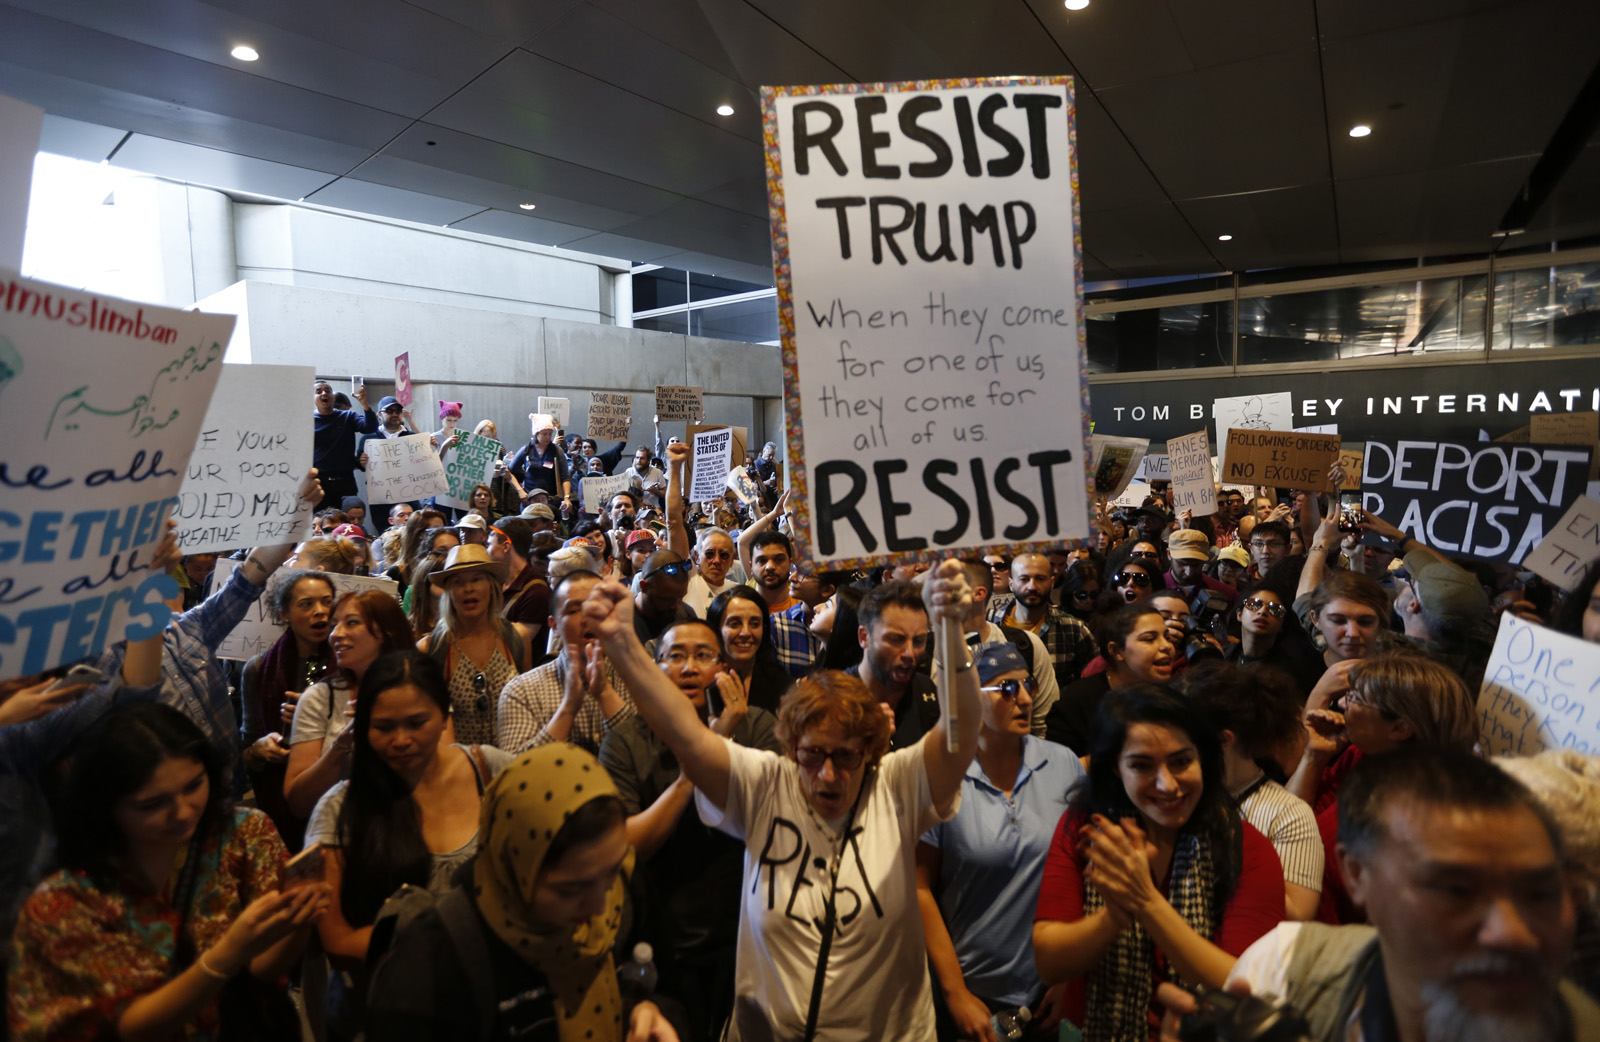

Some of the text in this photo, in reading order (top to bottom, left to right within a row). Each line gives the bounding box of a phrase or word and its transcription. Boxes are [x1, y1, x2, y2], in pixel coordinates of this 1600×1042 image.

[793, 93, 1062, 179] RESIST
[816, 196, 1037, 270] TRUMP
[807, 291, 1069, 345] When they come
[837, 334, 1045, 380] for one of us,
[591, 392, 609, 404] YOUR
[818, 381, 1036, 428] they come for
[1113, 405, 1169, 422] TOM
[1367, 388, 1600, 415] INTERNATI
[588, 425, 608, 437] COURT
[607, 417, 615, 425] UP
[237, 430, 289, 452] YOUR
[454, 429, 502, 452] WE MUST
[697, 432, 730, 446] THE UNITED
[854, 425, 888, 451] all
[911, 421, 936, 445] of
[1230, 433, 1340, 453] FOLLOWING ORDERS
[380, 443, 402, 458] THE
[404, 439, 428, 454] YEAR
[449, 442, 498, 463] PROTECT
[696, 442, 726, 455] STATES OF
[1271, 450, 1288, 462] IS
[85, 449, 178, 487] all
[383, 459, 401, 471] THE
[447, 462, 485, 482] OTHER
[456, 453, 487, 471] EACH
[1148, 457, 1169, 473] WE
[1341, 455, 1363, 469] ST
[386, 476, 403, 486] THE
[1173, 466, 1205, 486] against
[1231, 463, 1255, 478] NO
[1264, 465, 1321, 484] EXCUSE
[1362, 440, 1589, 507] DEPORT
[386, 490, 393, 500] A
[400, 480, 447, 498] COCK!
[1173, 490, 1197, 507] SLIM
[814, 449, 1072, 556] RESIST
[256, 520, 304, 542] FREE
[62, 550, 150, 594] all
[1485, 664, 1585, 724] person
[1493, 686, 1536, 731] they
